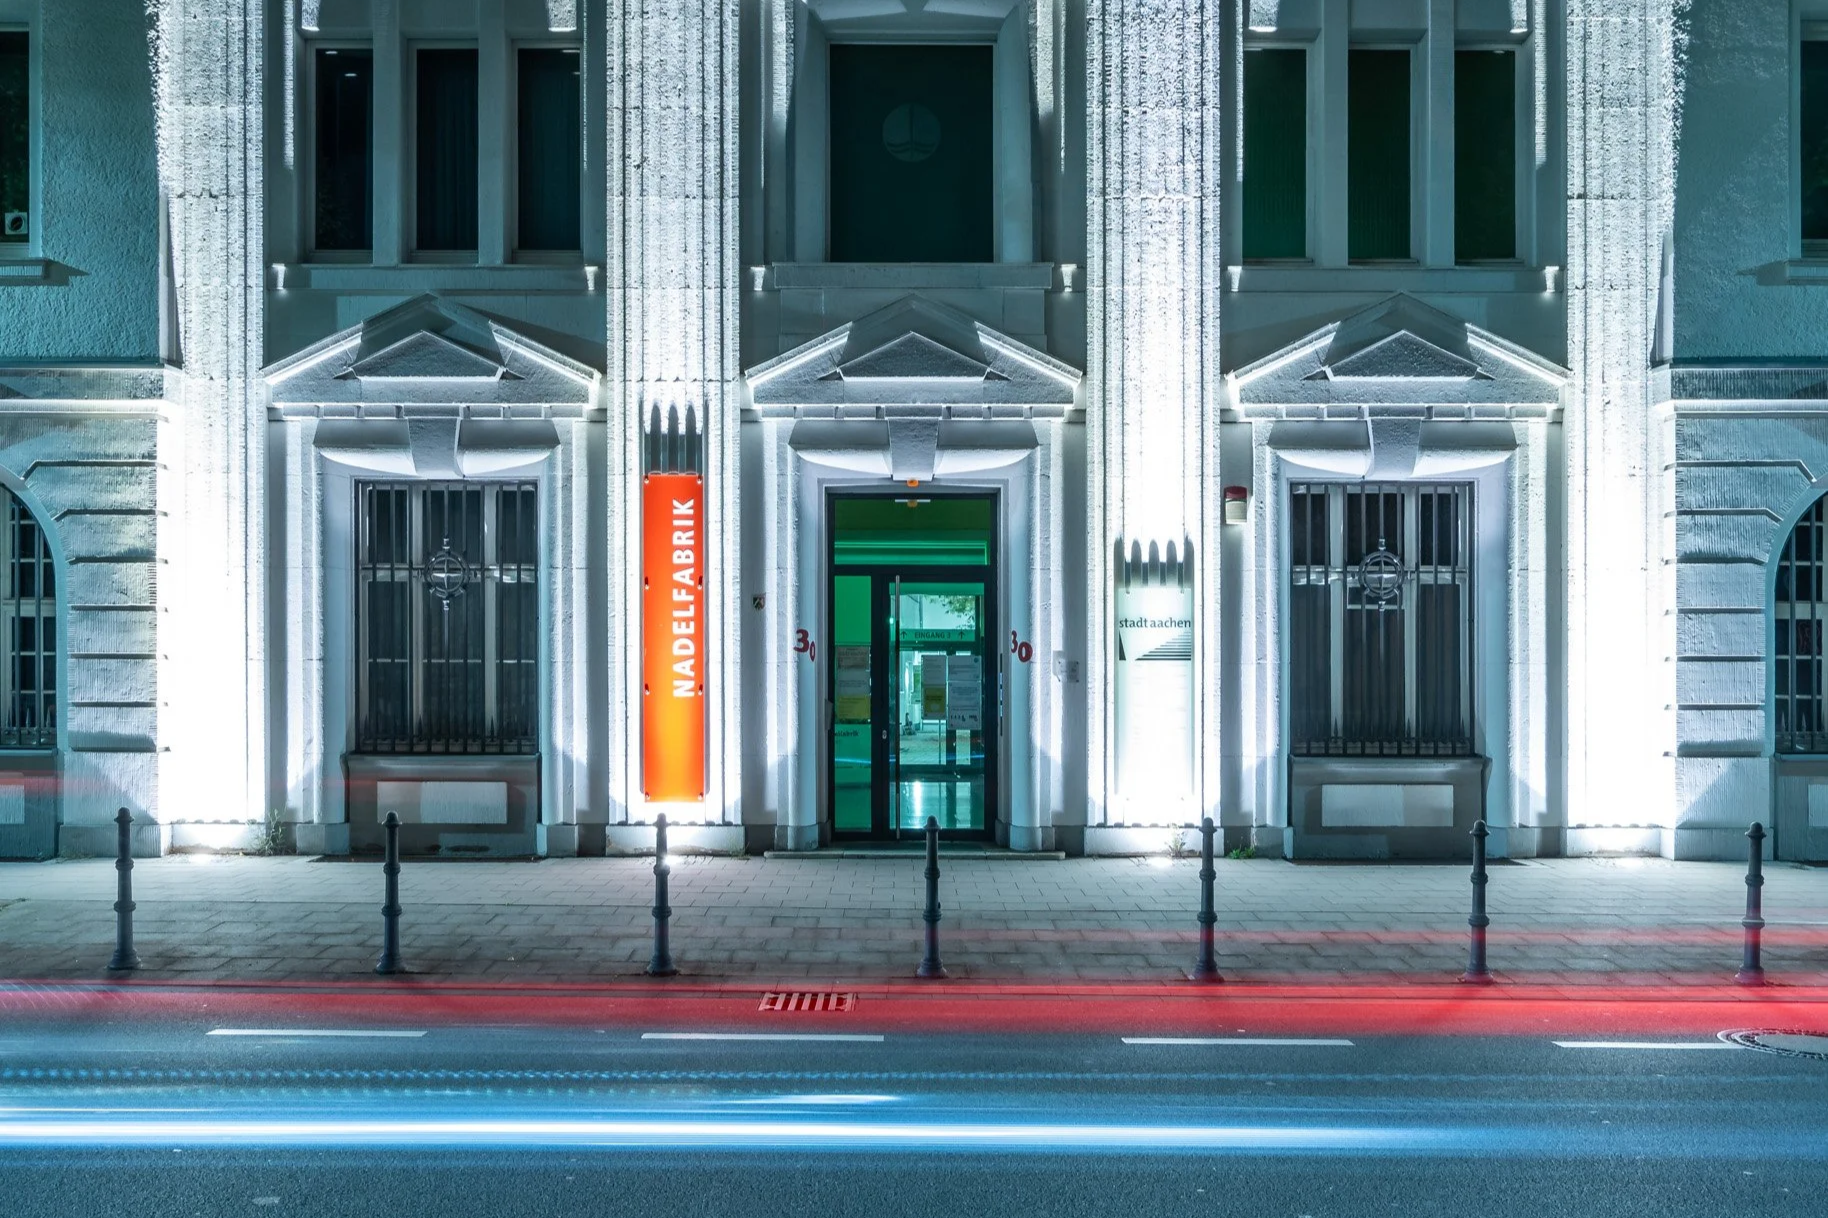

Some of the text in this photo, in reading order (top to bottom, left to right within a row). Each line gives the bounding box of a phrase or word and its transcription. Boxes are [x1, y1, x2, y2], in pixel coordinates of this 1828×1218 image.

[672, 499, 695, 697] NADELFABRIK
[793, 628, 816, 662] 30
[914, 631, 945, 639] EINGANG
[1011, 630, 1033, 663] 30
